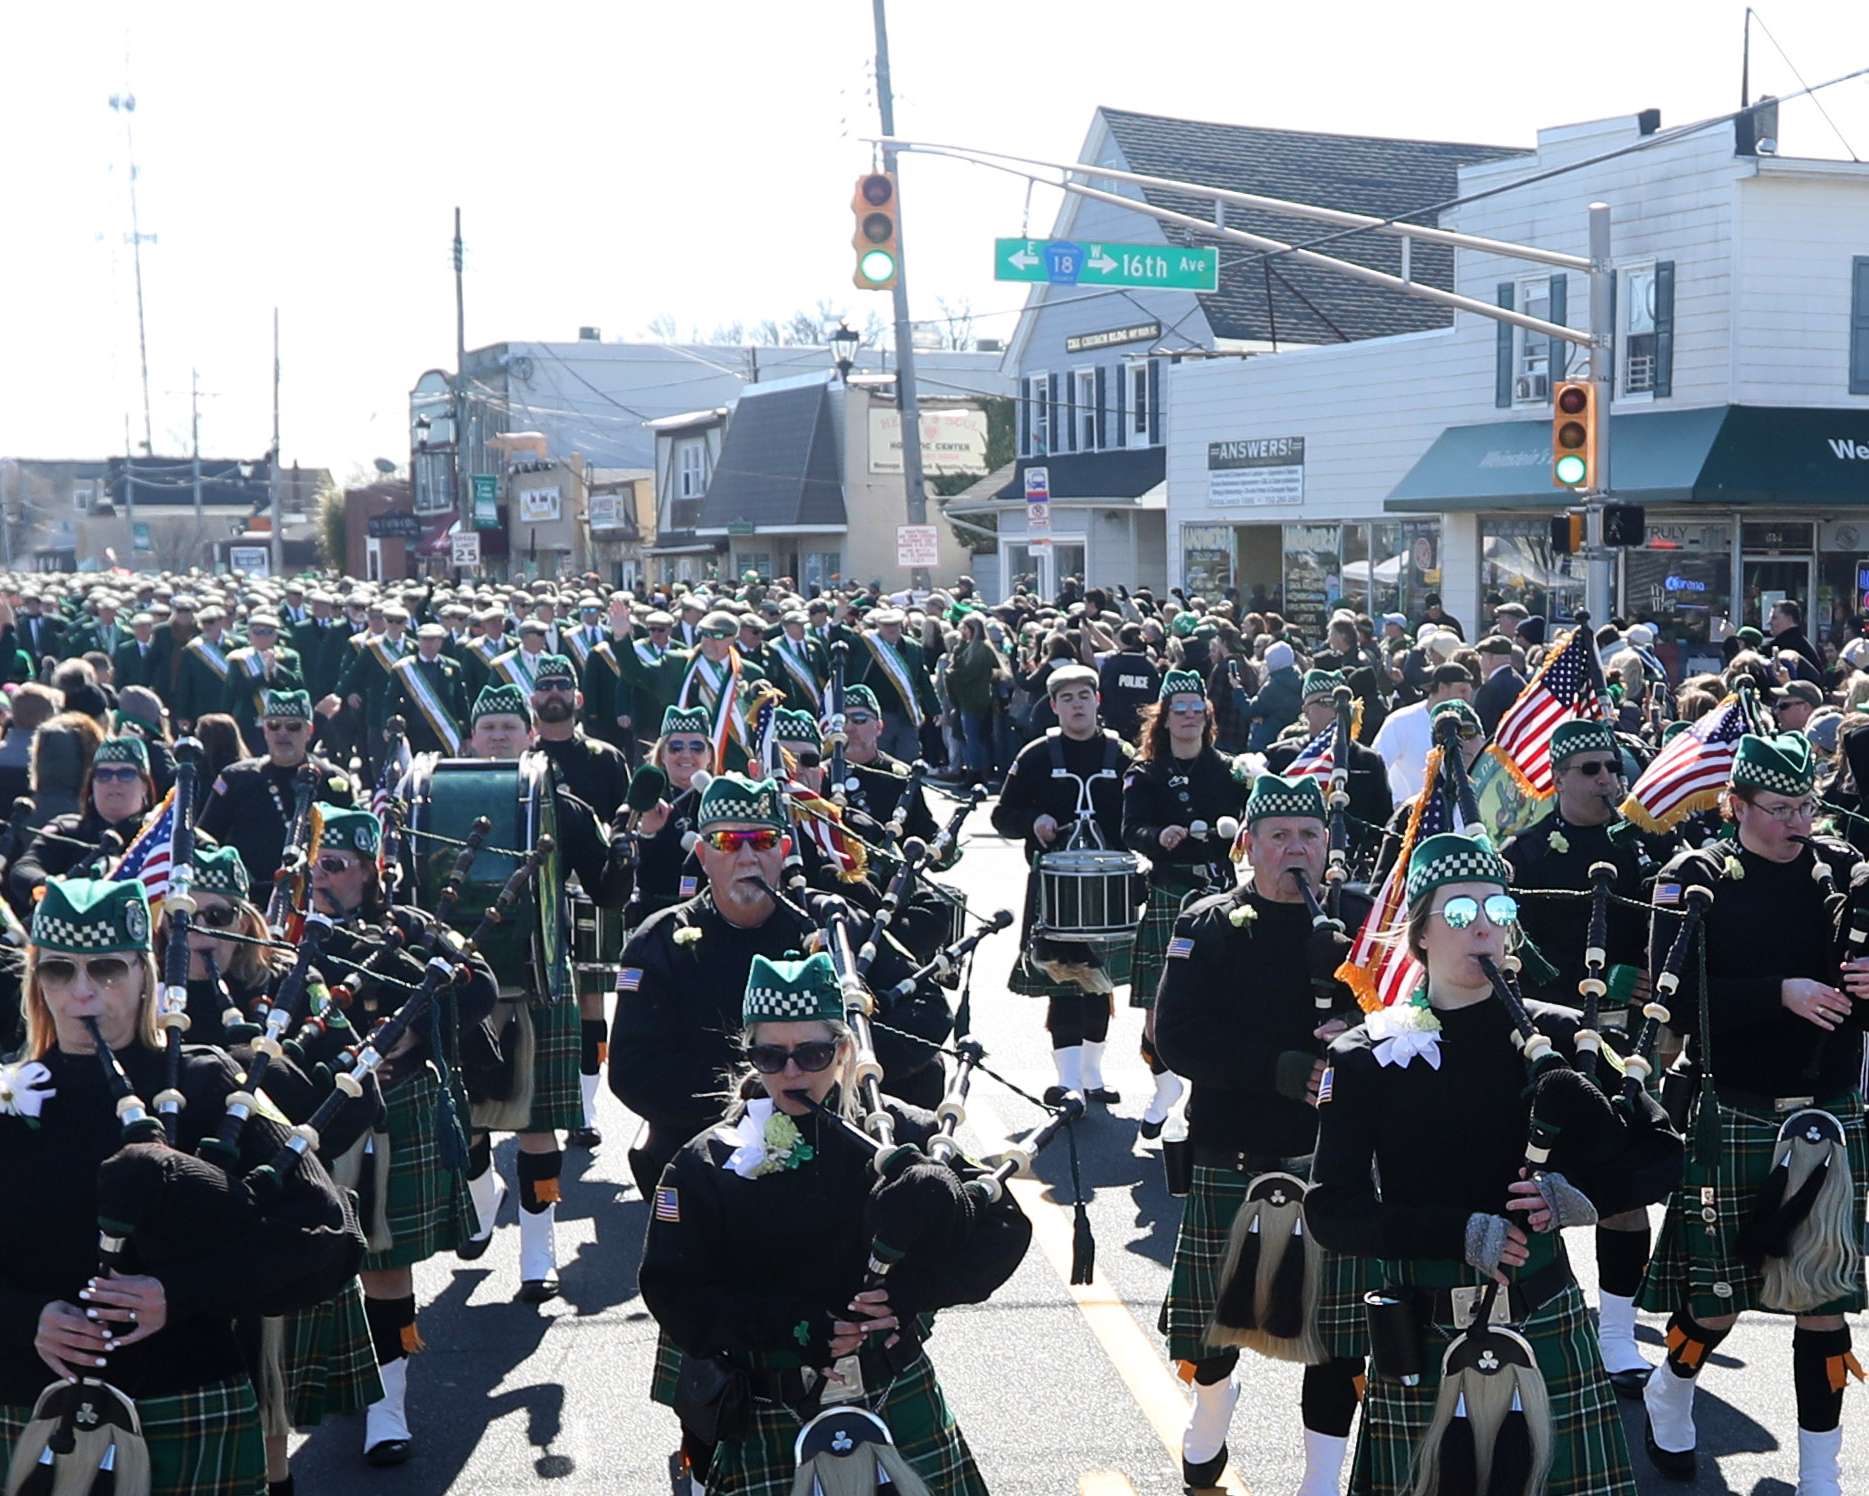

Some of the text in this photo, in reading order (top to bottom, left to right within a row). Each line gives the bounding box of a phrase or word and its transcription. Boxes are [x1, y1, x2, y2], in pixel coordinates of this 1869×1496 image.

[1027, 241, 1206, 278] E W 16th Ave
[1053, 256, 1074, 273] 18
[935, 442, 971, 451] CENTER
[1645, 525, 1688, 540] TRULY
[455, 548, 477, 562] 25
[1665, 575, 1706, 592] Corona
[1118, 674, 1149, 689] POLICE
